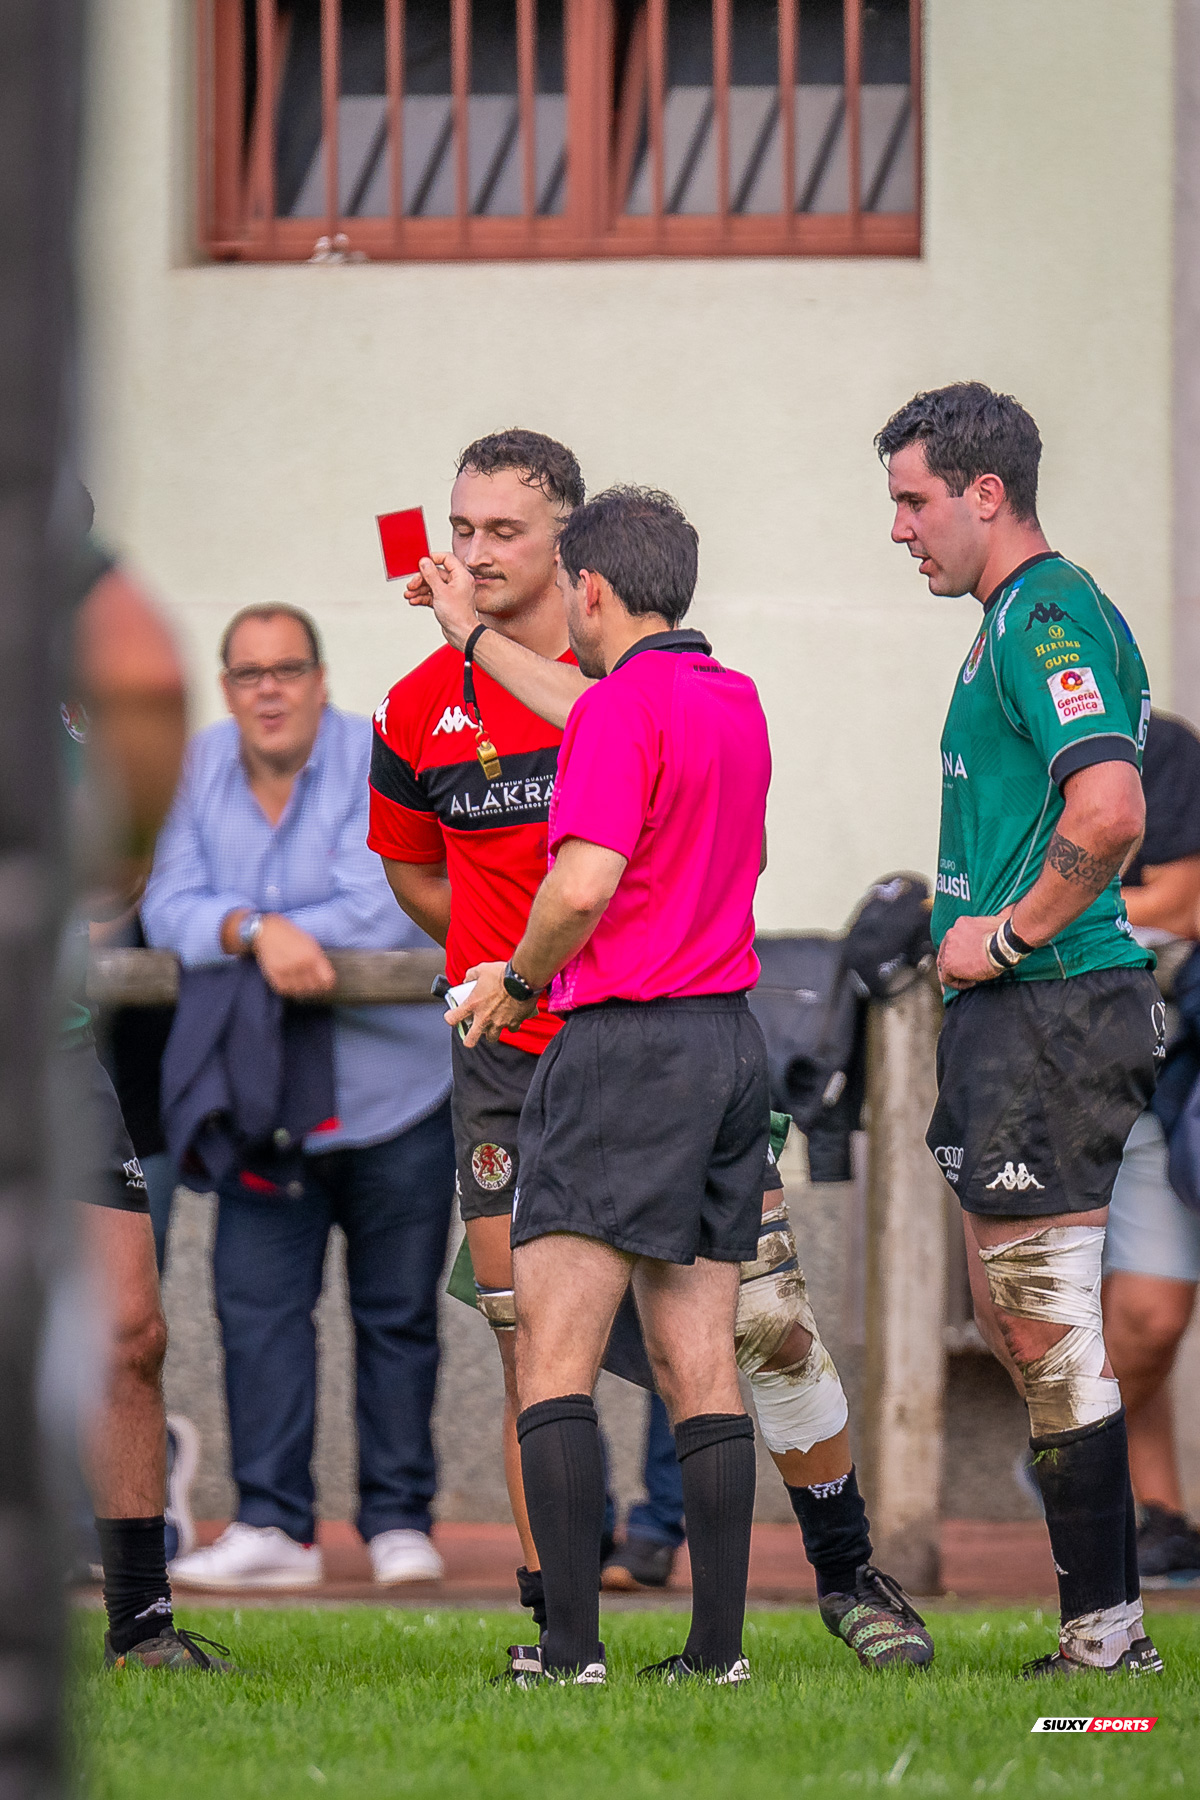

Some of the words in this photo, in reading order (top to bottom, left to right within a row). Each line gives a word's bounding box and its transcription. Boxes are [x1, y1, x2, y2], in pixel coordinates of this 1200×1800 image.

[1045, 653, 1080, 669] GUYO
[1057, 690, 1099, 710] General
[1063, 701, 1098, 717] Optica
[491, 780, 523, 788] PREMIUM
[525, 774, 554, 782] QUALITY
[450, 780, 555, 816] ALAKRA
[469, 808, 503, 818] EXPERTOS
